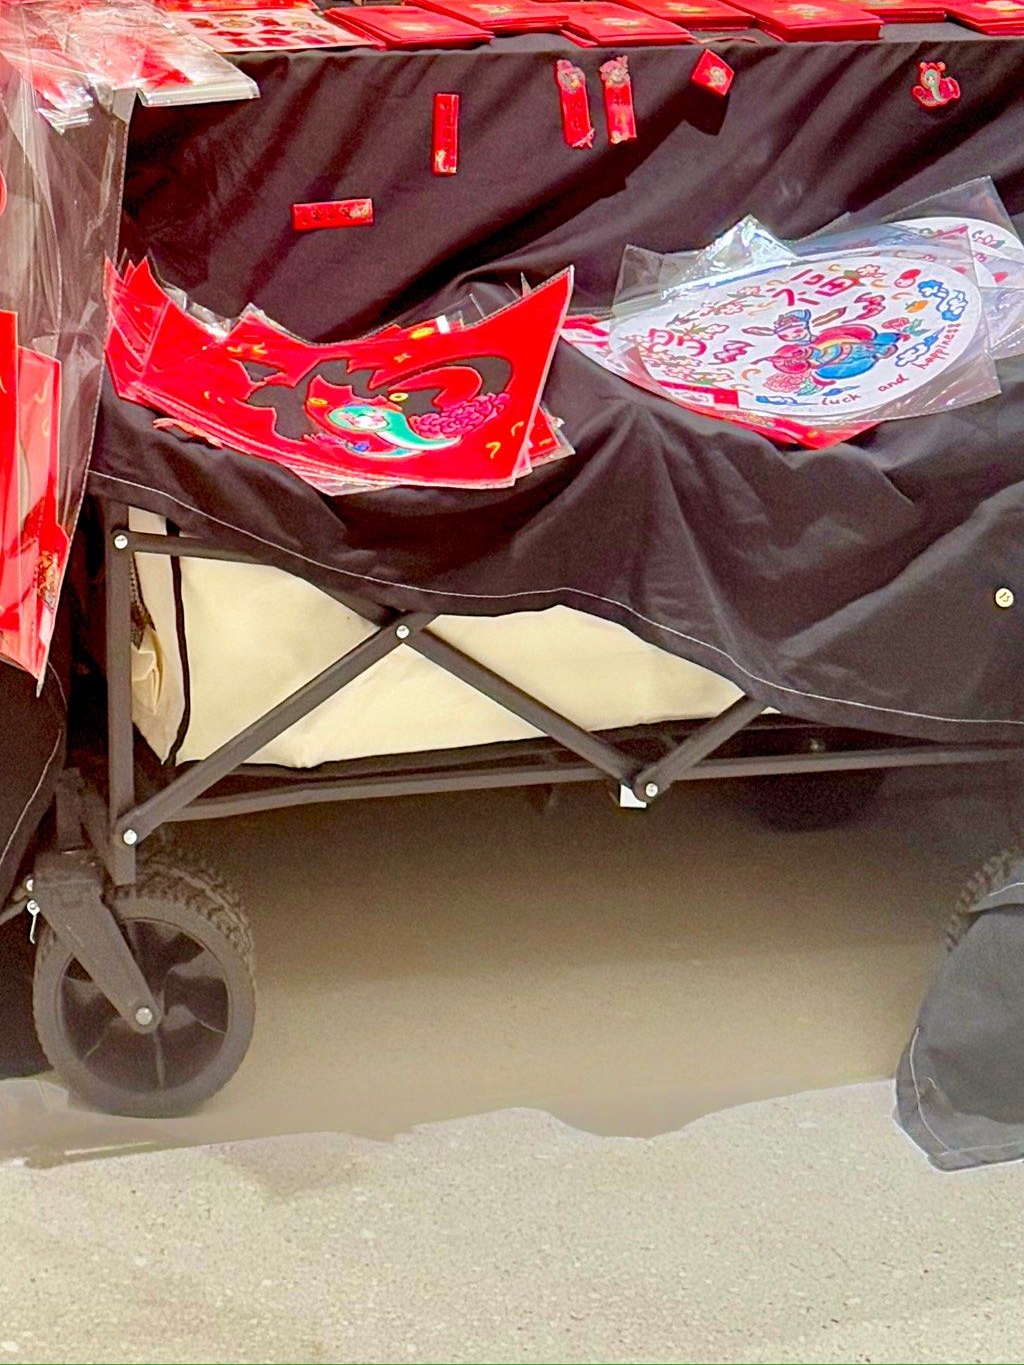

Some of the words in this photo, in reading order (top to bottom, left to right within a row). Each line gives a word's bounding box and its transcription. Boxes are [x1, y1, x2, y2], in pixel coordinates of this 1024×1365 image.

[821, 391, 862, 406] luck
[878, 374, 908, 392] and
[915, 322, 962, 370] happiness
